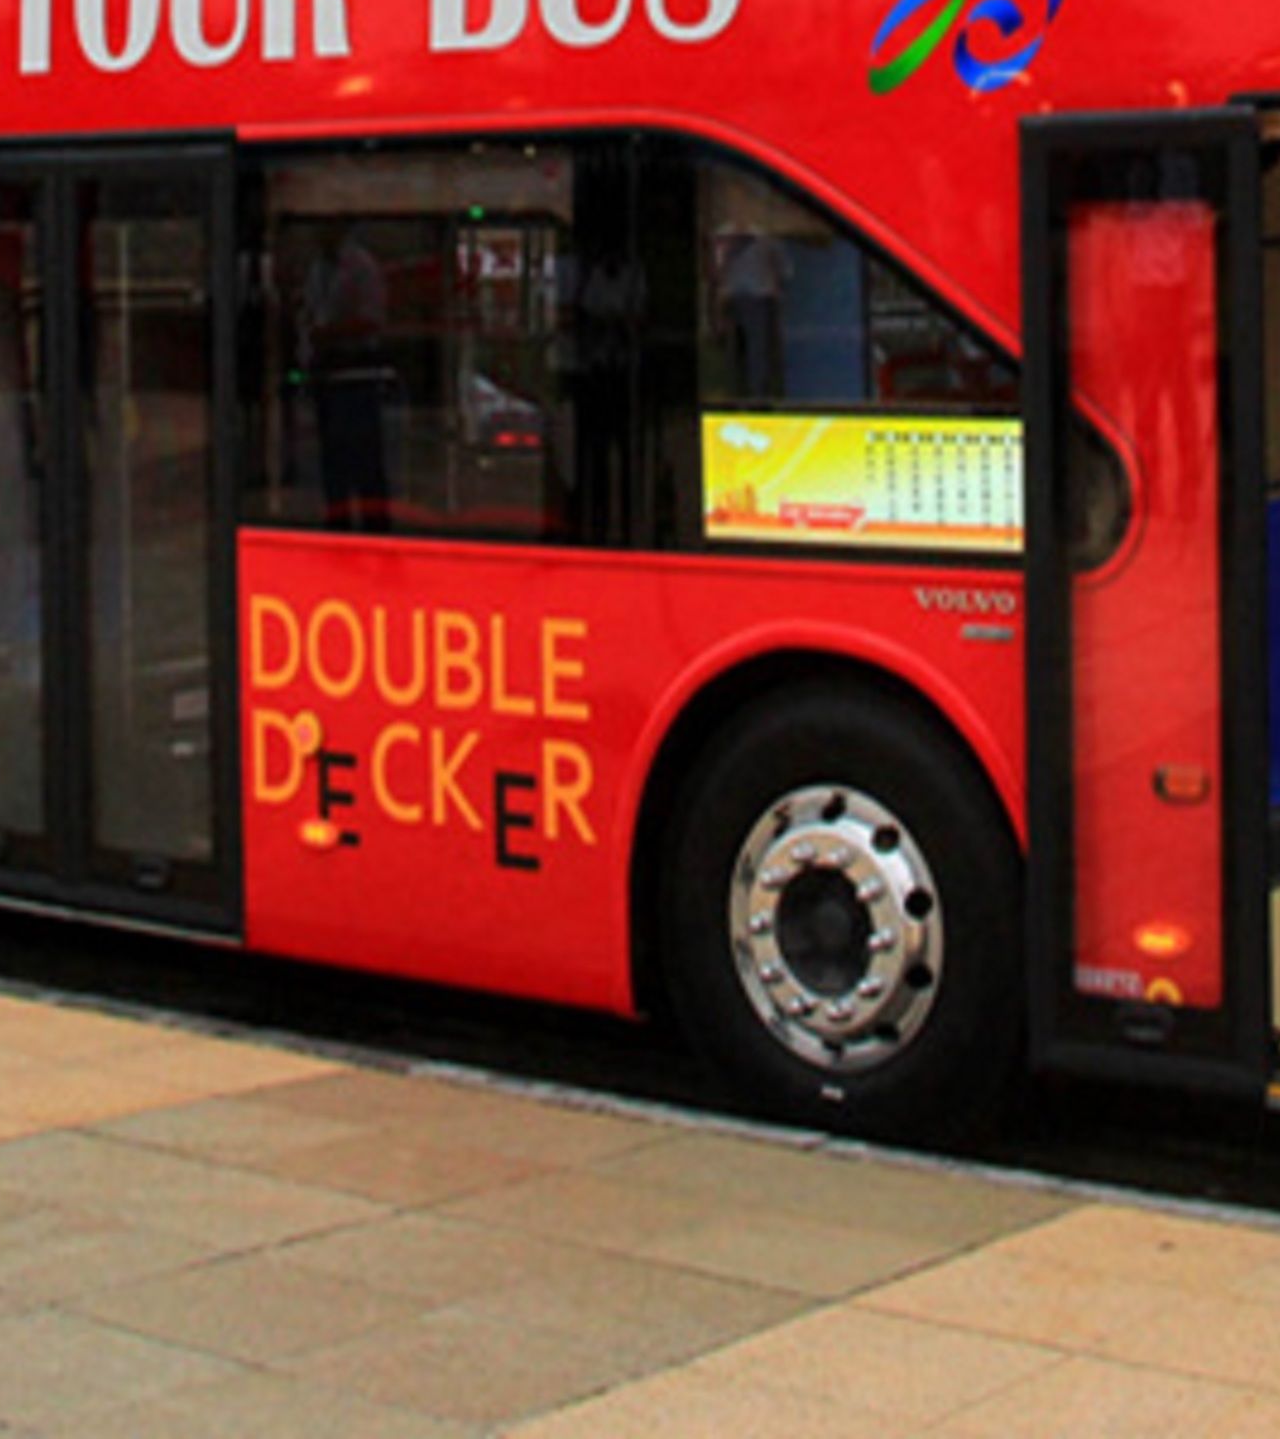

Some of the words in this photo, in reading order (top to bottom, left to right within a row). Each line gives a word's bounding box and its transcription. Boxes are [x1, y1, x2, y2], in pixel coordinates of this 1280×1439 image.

[250, 595, 590, 720] DOUBLE
[913, 585, 1016, 615] VOLVO
[252, 709, 596, 871] DECKER
